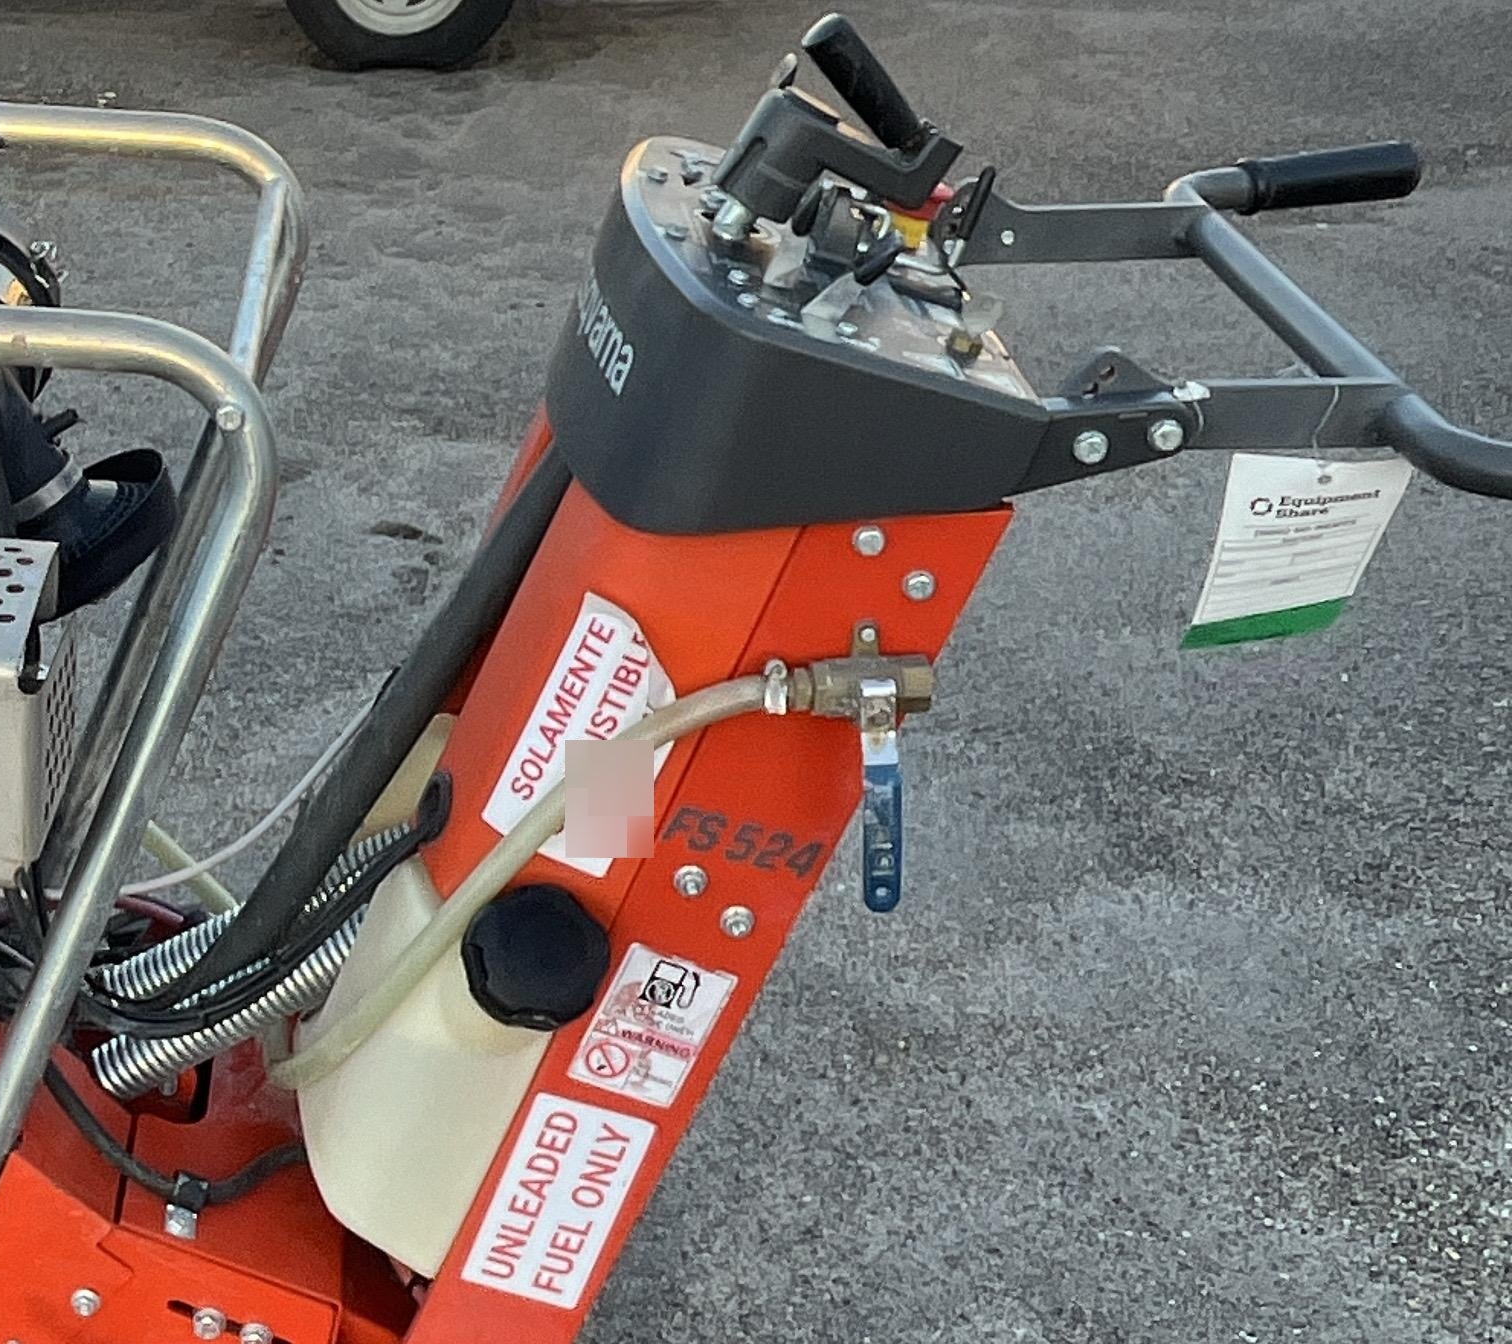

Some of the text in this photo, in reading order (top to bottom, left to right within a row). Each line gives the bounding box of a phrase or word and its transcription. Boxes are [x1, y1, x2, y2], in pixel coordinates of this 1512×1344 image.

[1275, 508, 1329, 518] Share
[1279, 489, 1381, 507] Equipment
[510, 616, 616, 802] SOLAMENTE
[662, 806, 728, 852] FS
[725, 821, 826, 878] 524
[481, 1110, 579, 1279] UNLEADED
[531, 1122, 631, 1295] FUEL ONLY
